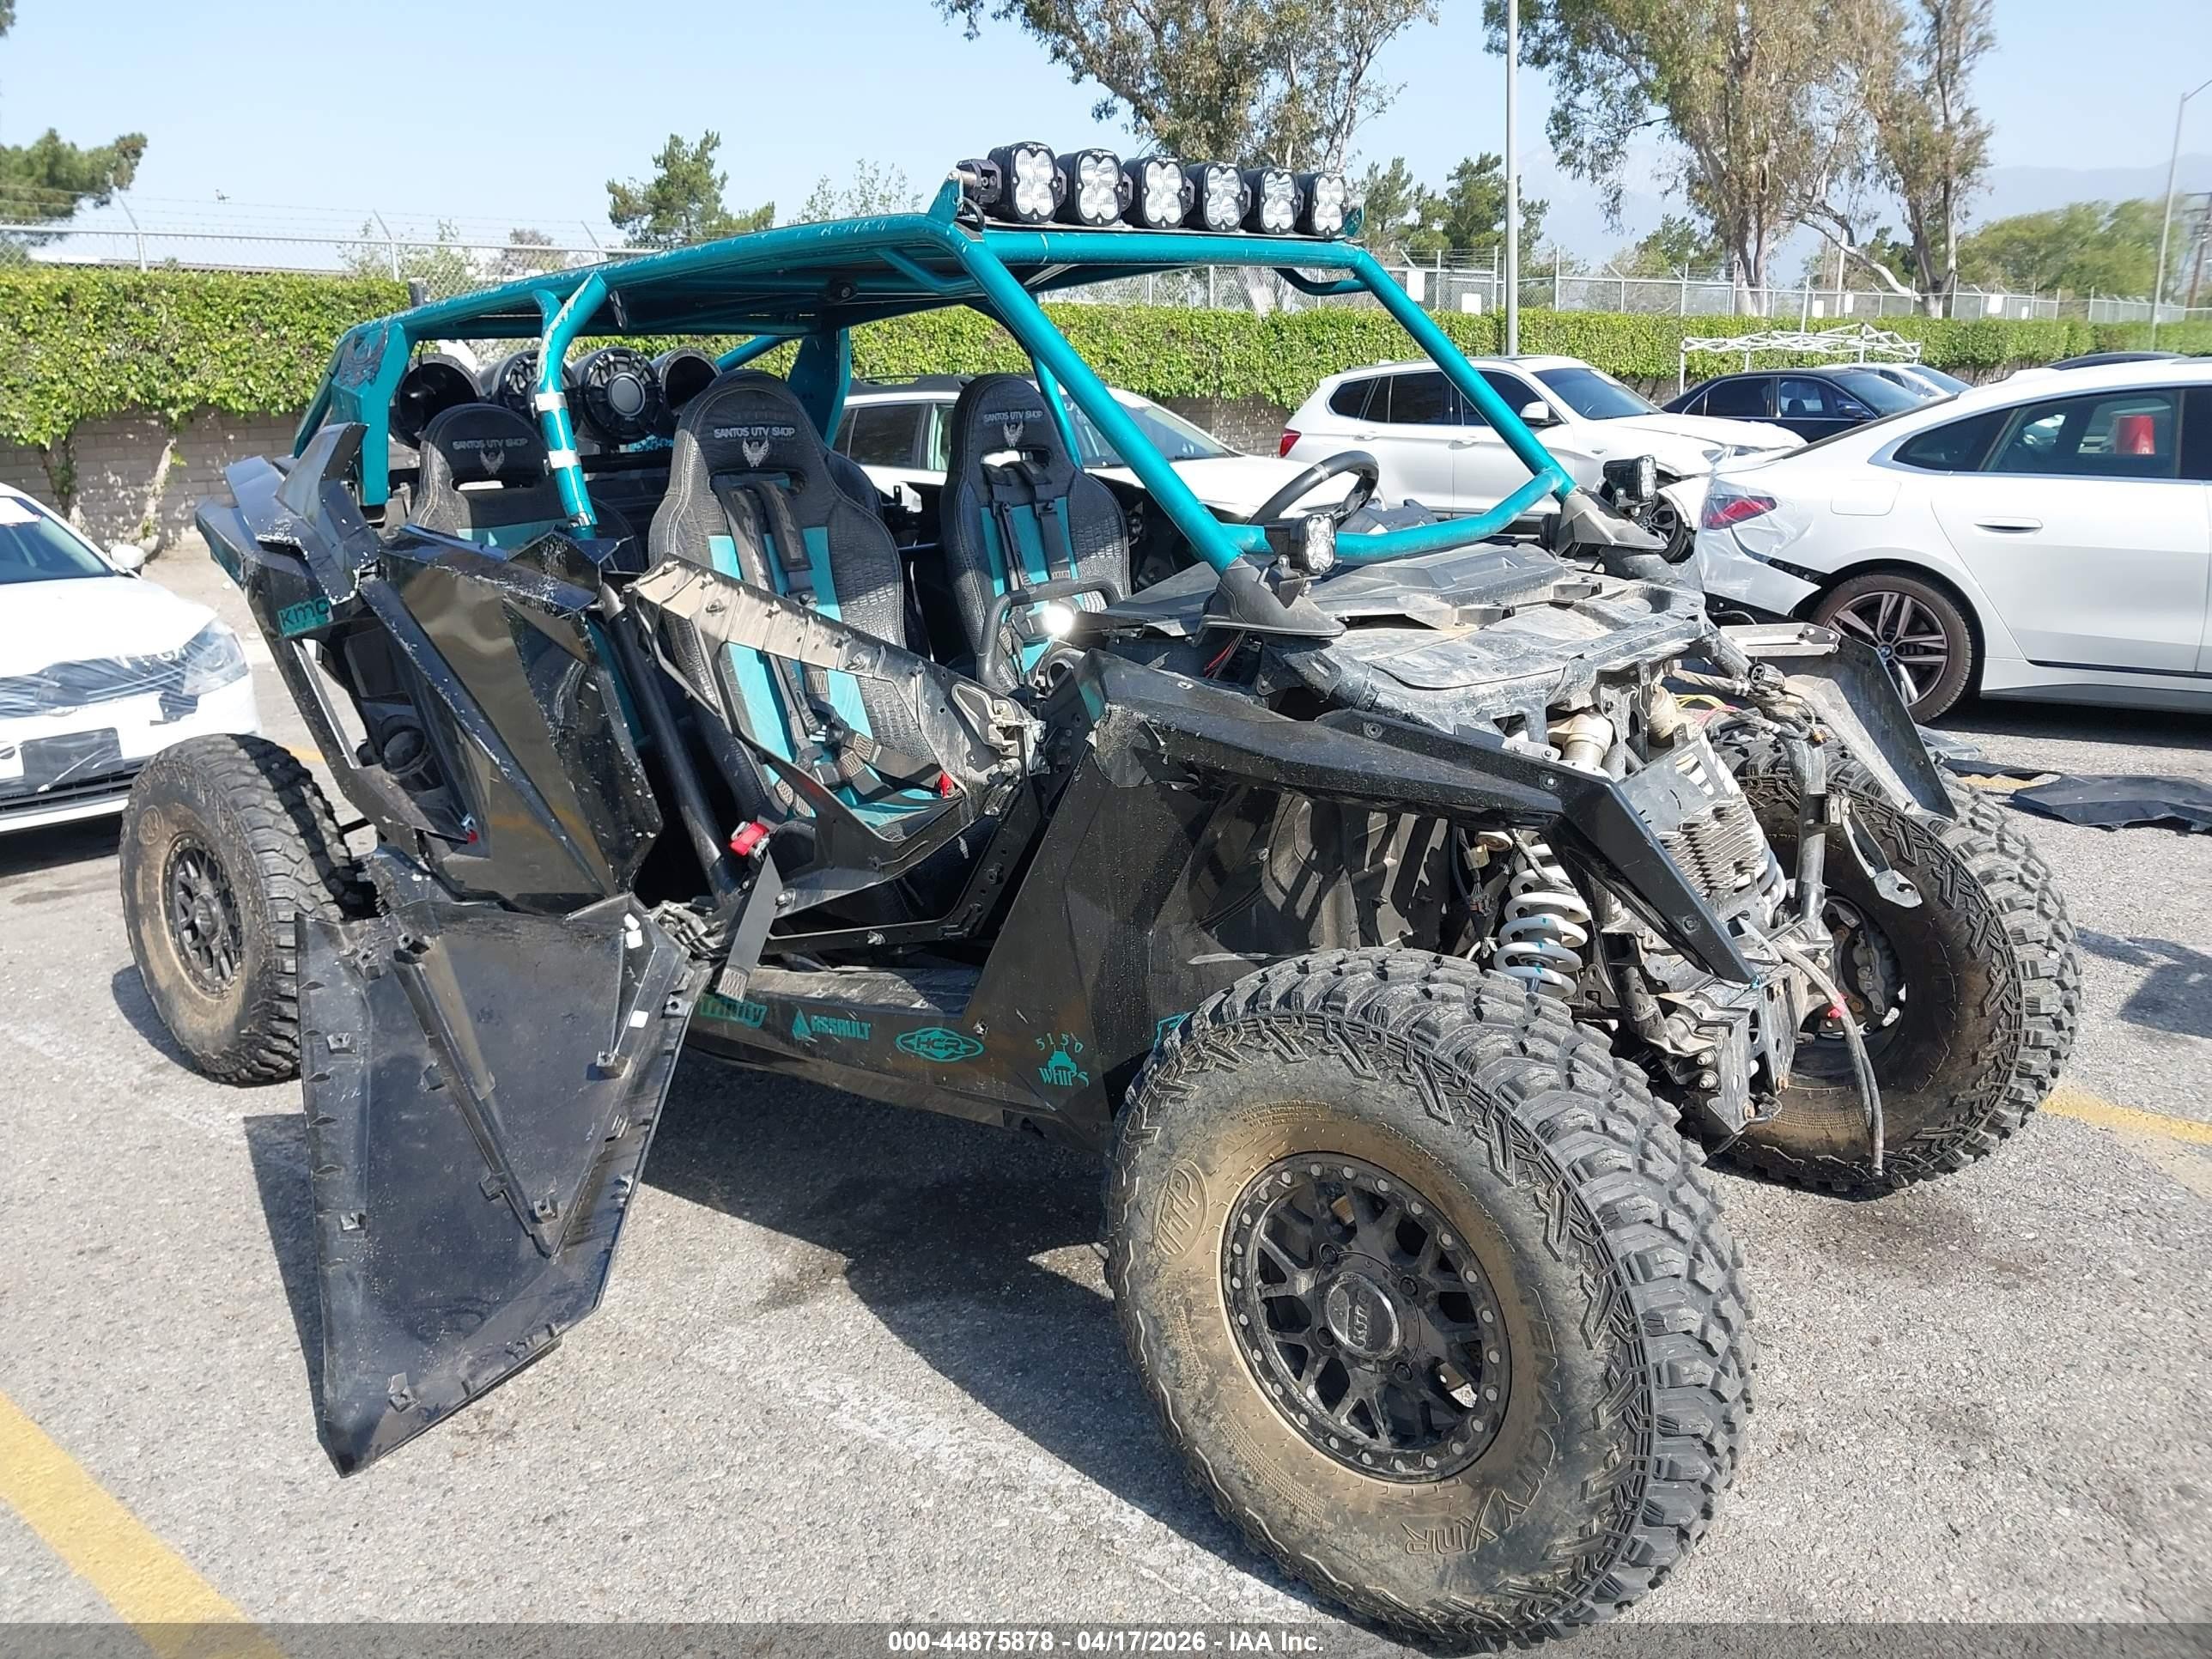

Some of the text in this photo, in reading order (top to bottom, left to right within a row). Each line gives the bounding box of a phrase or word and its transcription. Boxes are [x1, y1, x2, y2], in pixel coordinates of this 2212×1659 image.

[714, 426, 795, 439] SANTOS UTV SHOP
[810, 1014, 872, 1041] ASSAULT
